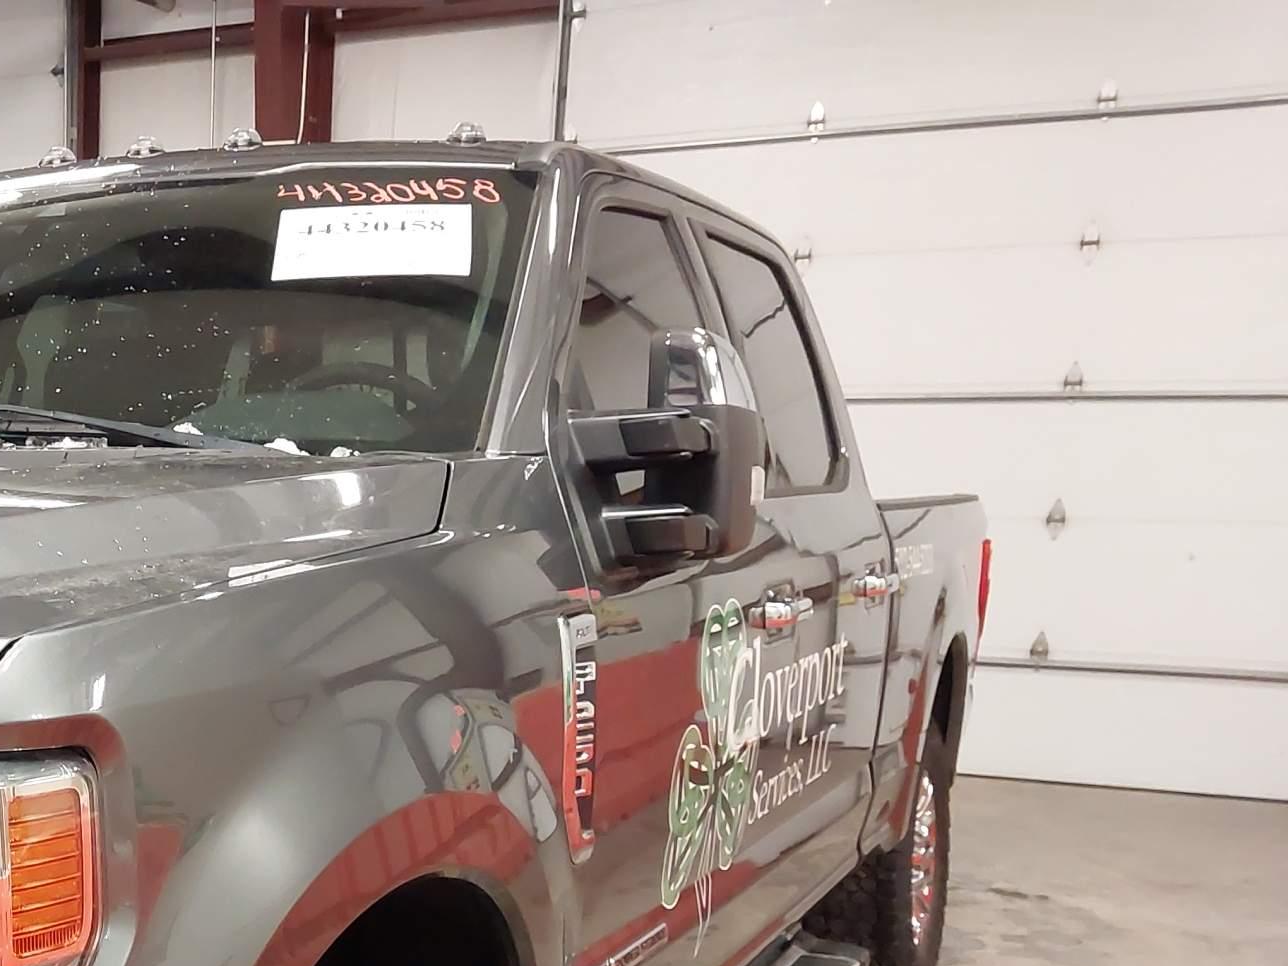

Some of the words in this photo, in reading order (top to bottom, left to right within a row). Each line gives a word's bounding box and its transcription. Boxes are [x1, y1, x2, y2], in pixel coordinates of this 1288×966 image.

[277, 178, 501, 203] 44320458
[727, 632, 848, 752] Cloverport
[805, 723, 837, 786] LLC
